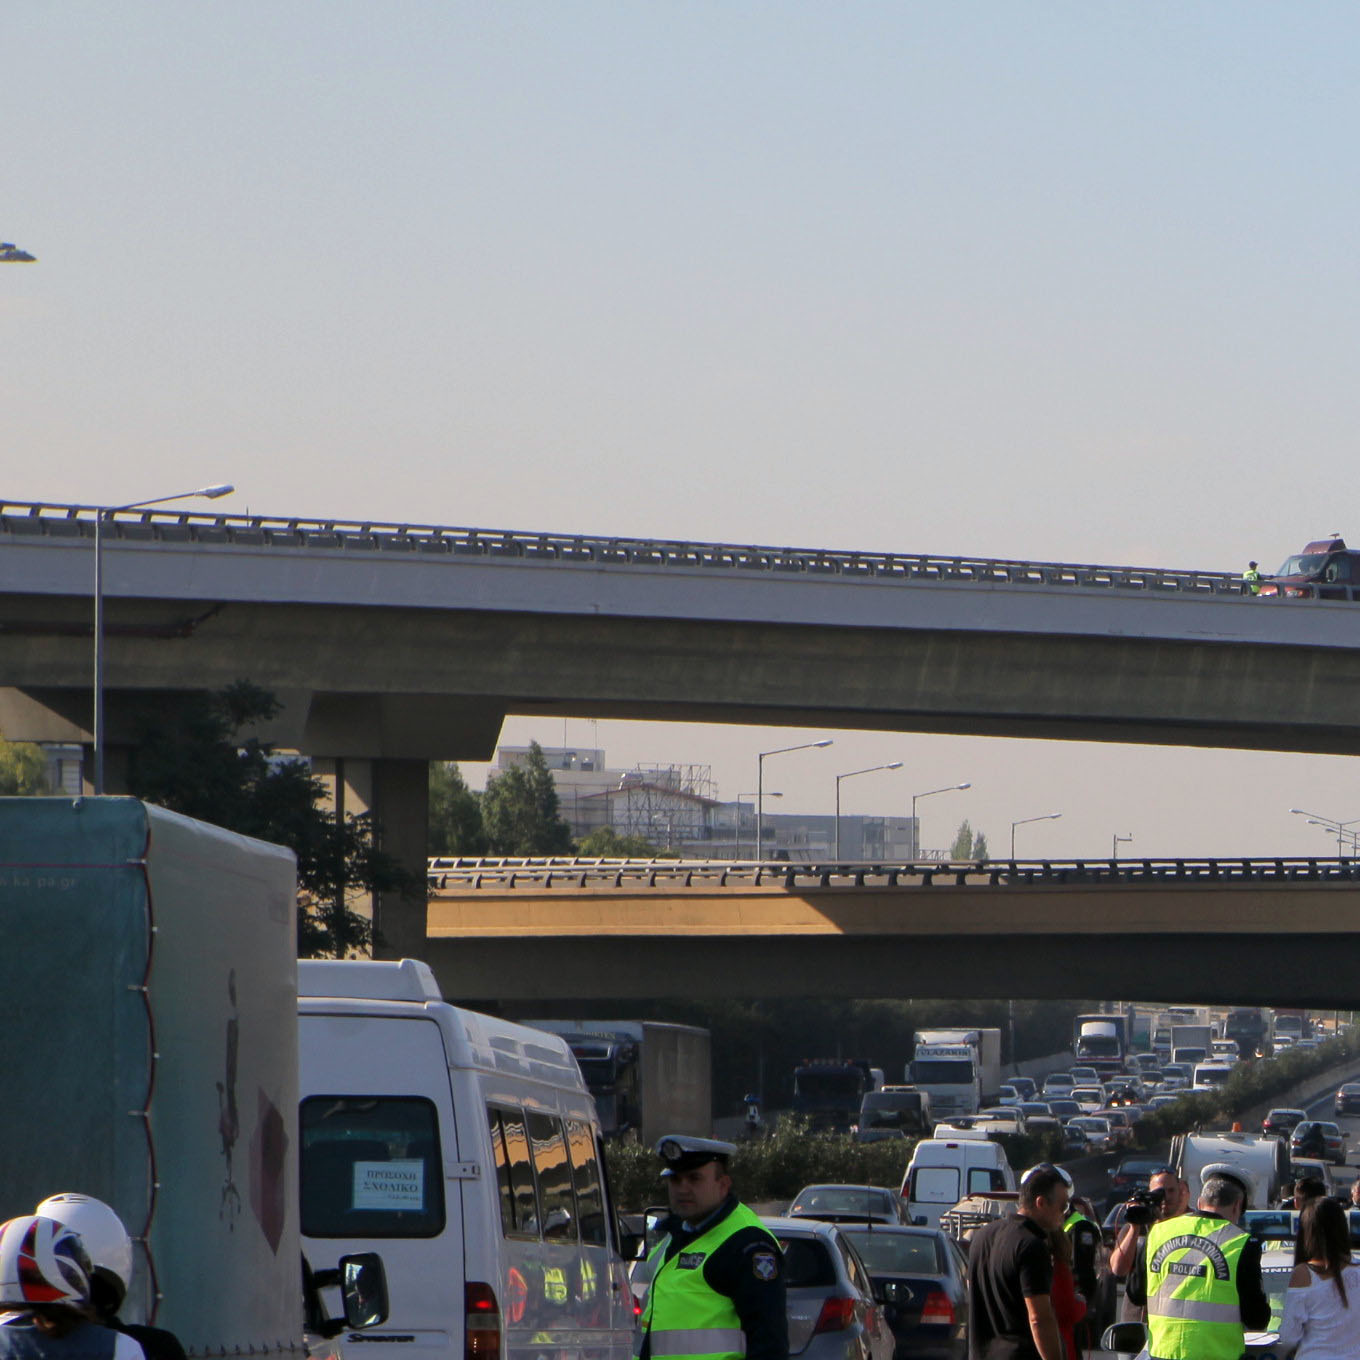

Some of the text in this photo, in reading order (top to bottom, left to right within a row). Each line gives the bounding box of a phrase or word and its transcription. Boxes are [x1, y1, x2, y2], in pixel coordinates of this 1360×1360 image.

[367, 1169, 417, 1181] ΠΡΟΣΟΧΗ
[362, 1181, 418, 1193] ΣΧΟΛΙΚΟ
[1172, 1263, 1202, 1275] POLICE
